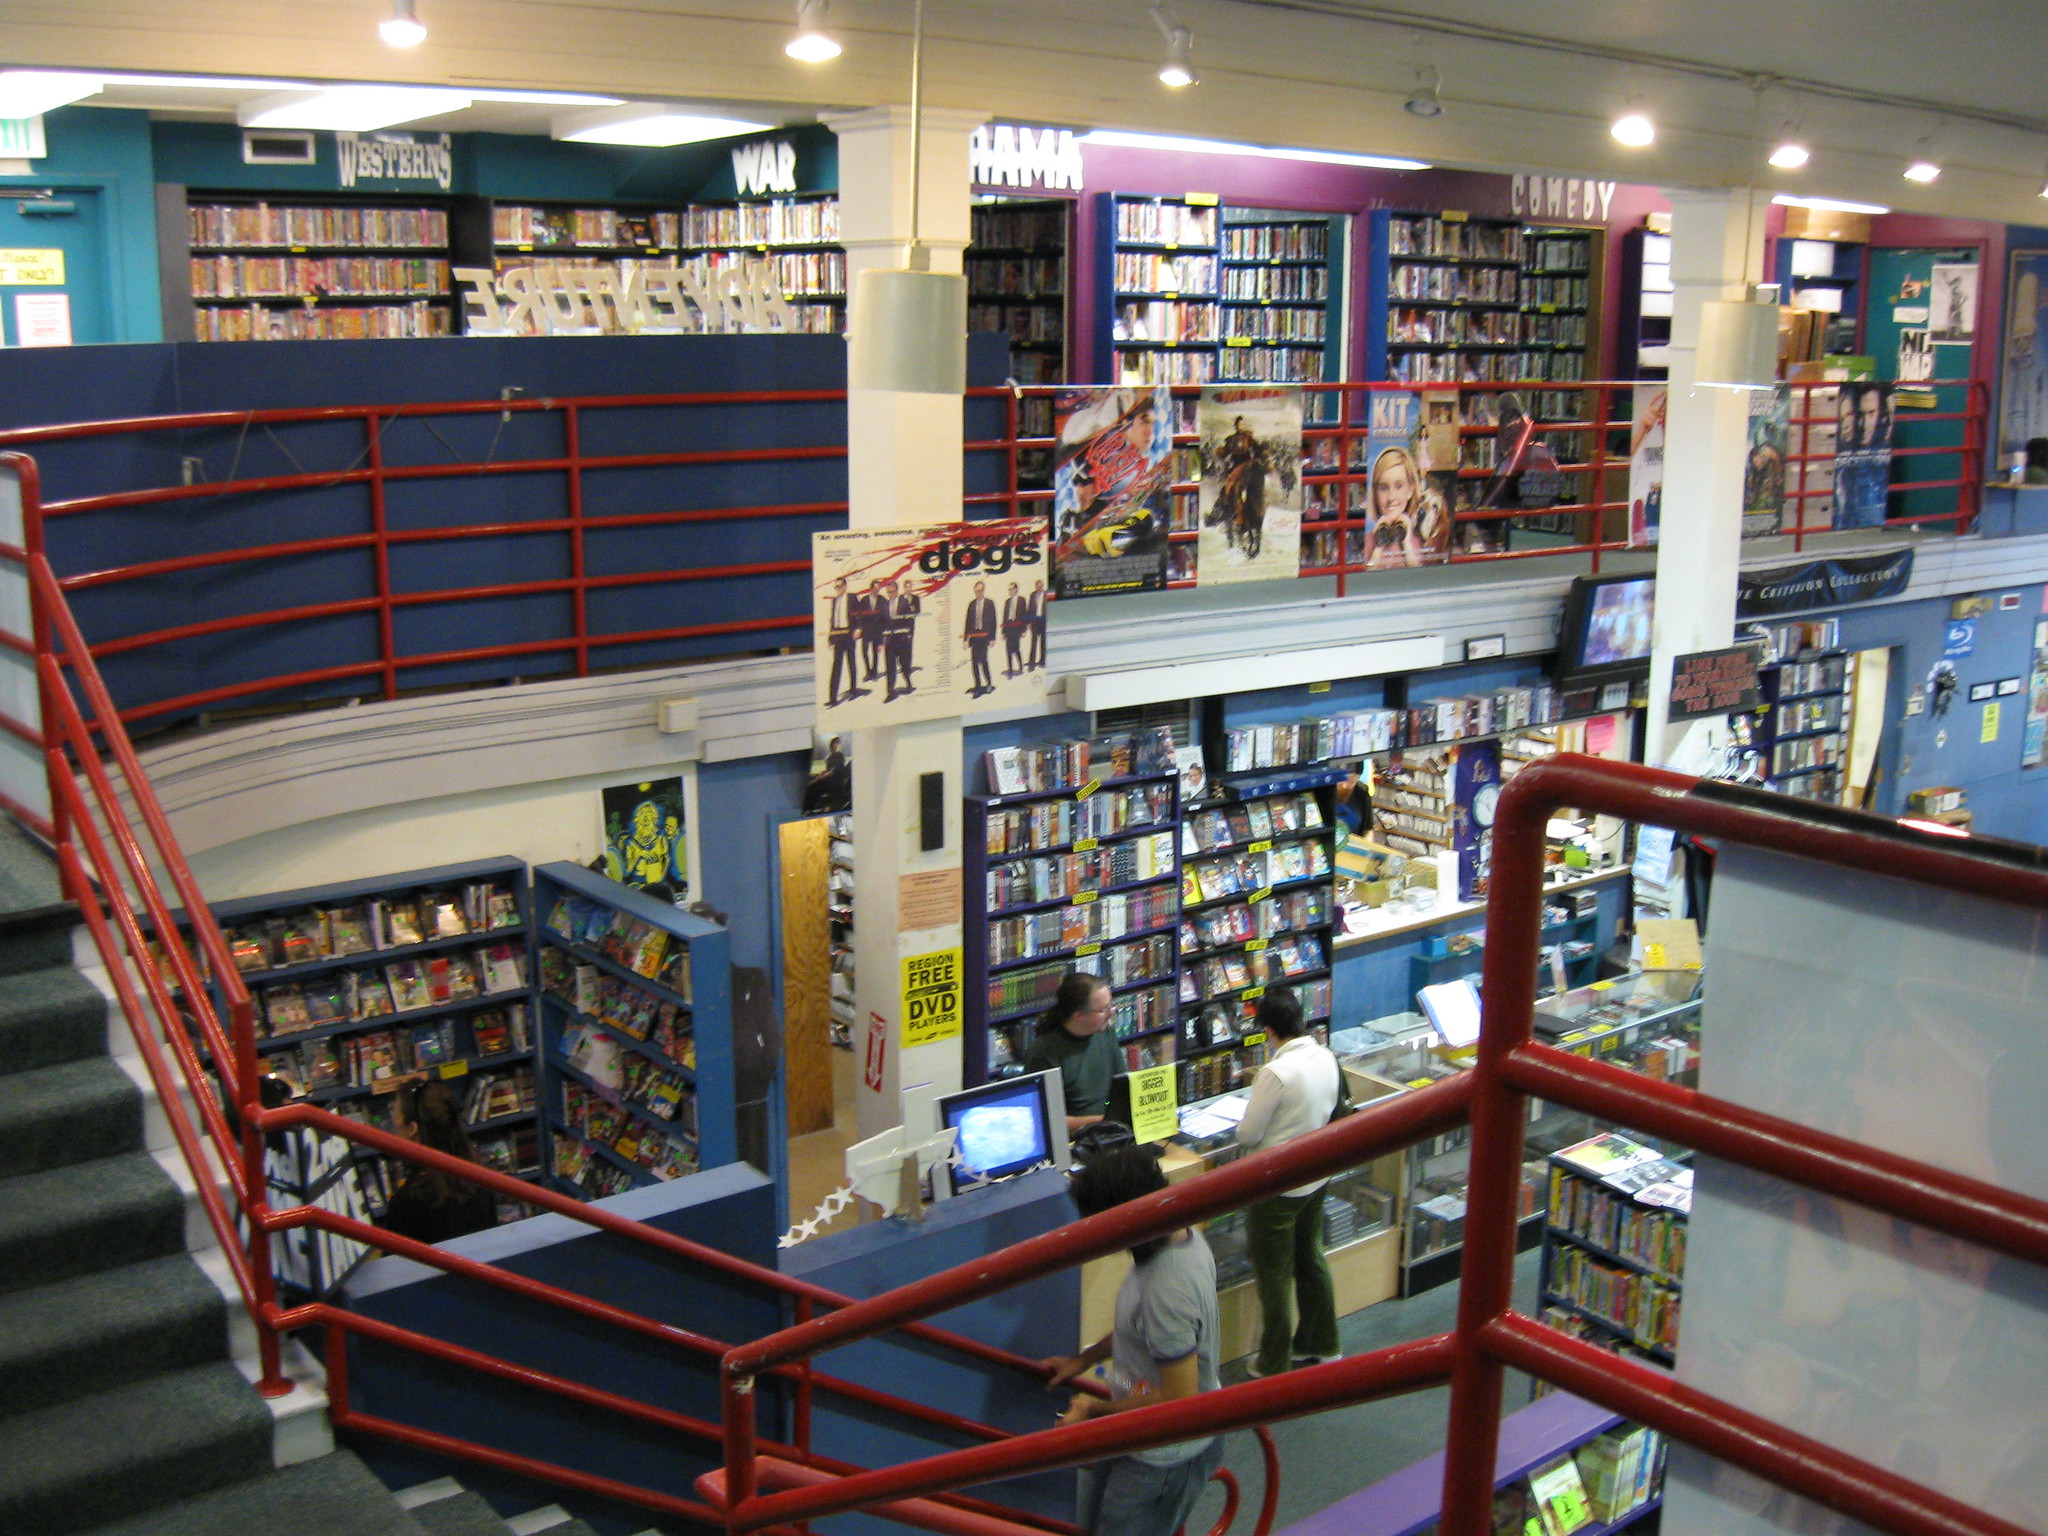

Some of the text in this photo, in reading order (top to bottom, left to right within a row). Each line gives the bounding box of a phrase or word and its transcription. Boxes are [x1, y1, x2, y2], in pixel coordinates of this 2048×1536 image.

[336, 132, 452, 189] WESTERNS
[731, 141, 797, 195] WAR
[969, 124, 1083, 190] RAMA
[1510, 174, 1616, 222] COMEDY
[1373, 398, 1410, 428] KIT
[919, 541, 1042, 574] dogs
[908, 954, 954, 970] REGION
[908, 965, 954, 988] FREE
[909, 993, 956, 1019] DVD
[909, 1014, 956, 1031] PLAYERS
